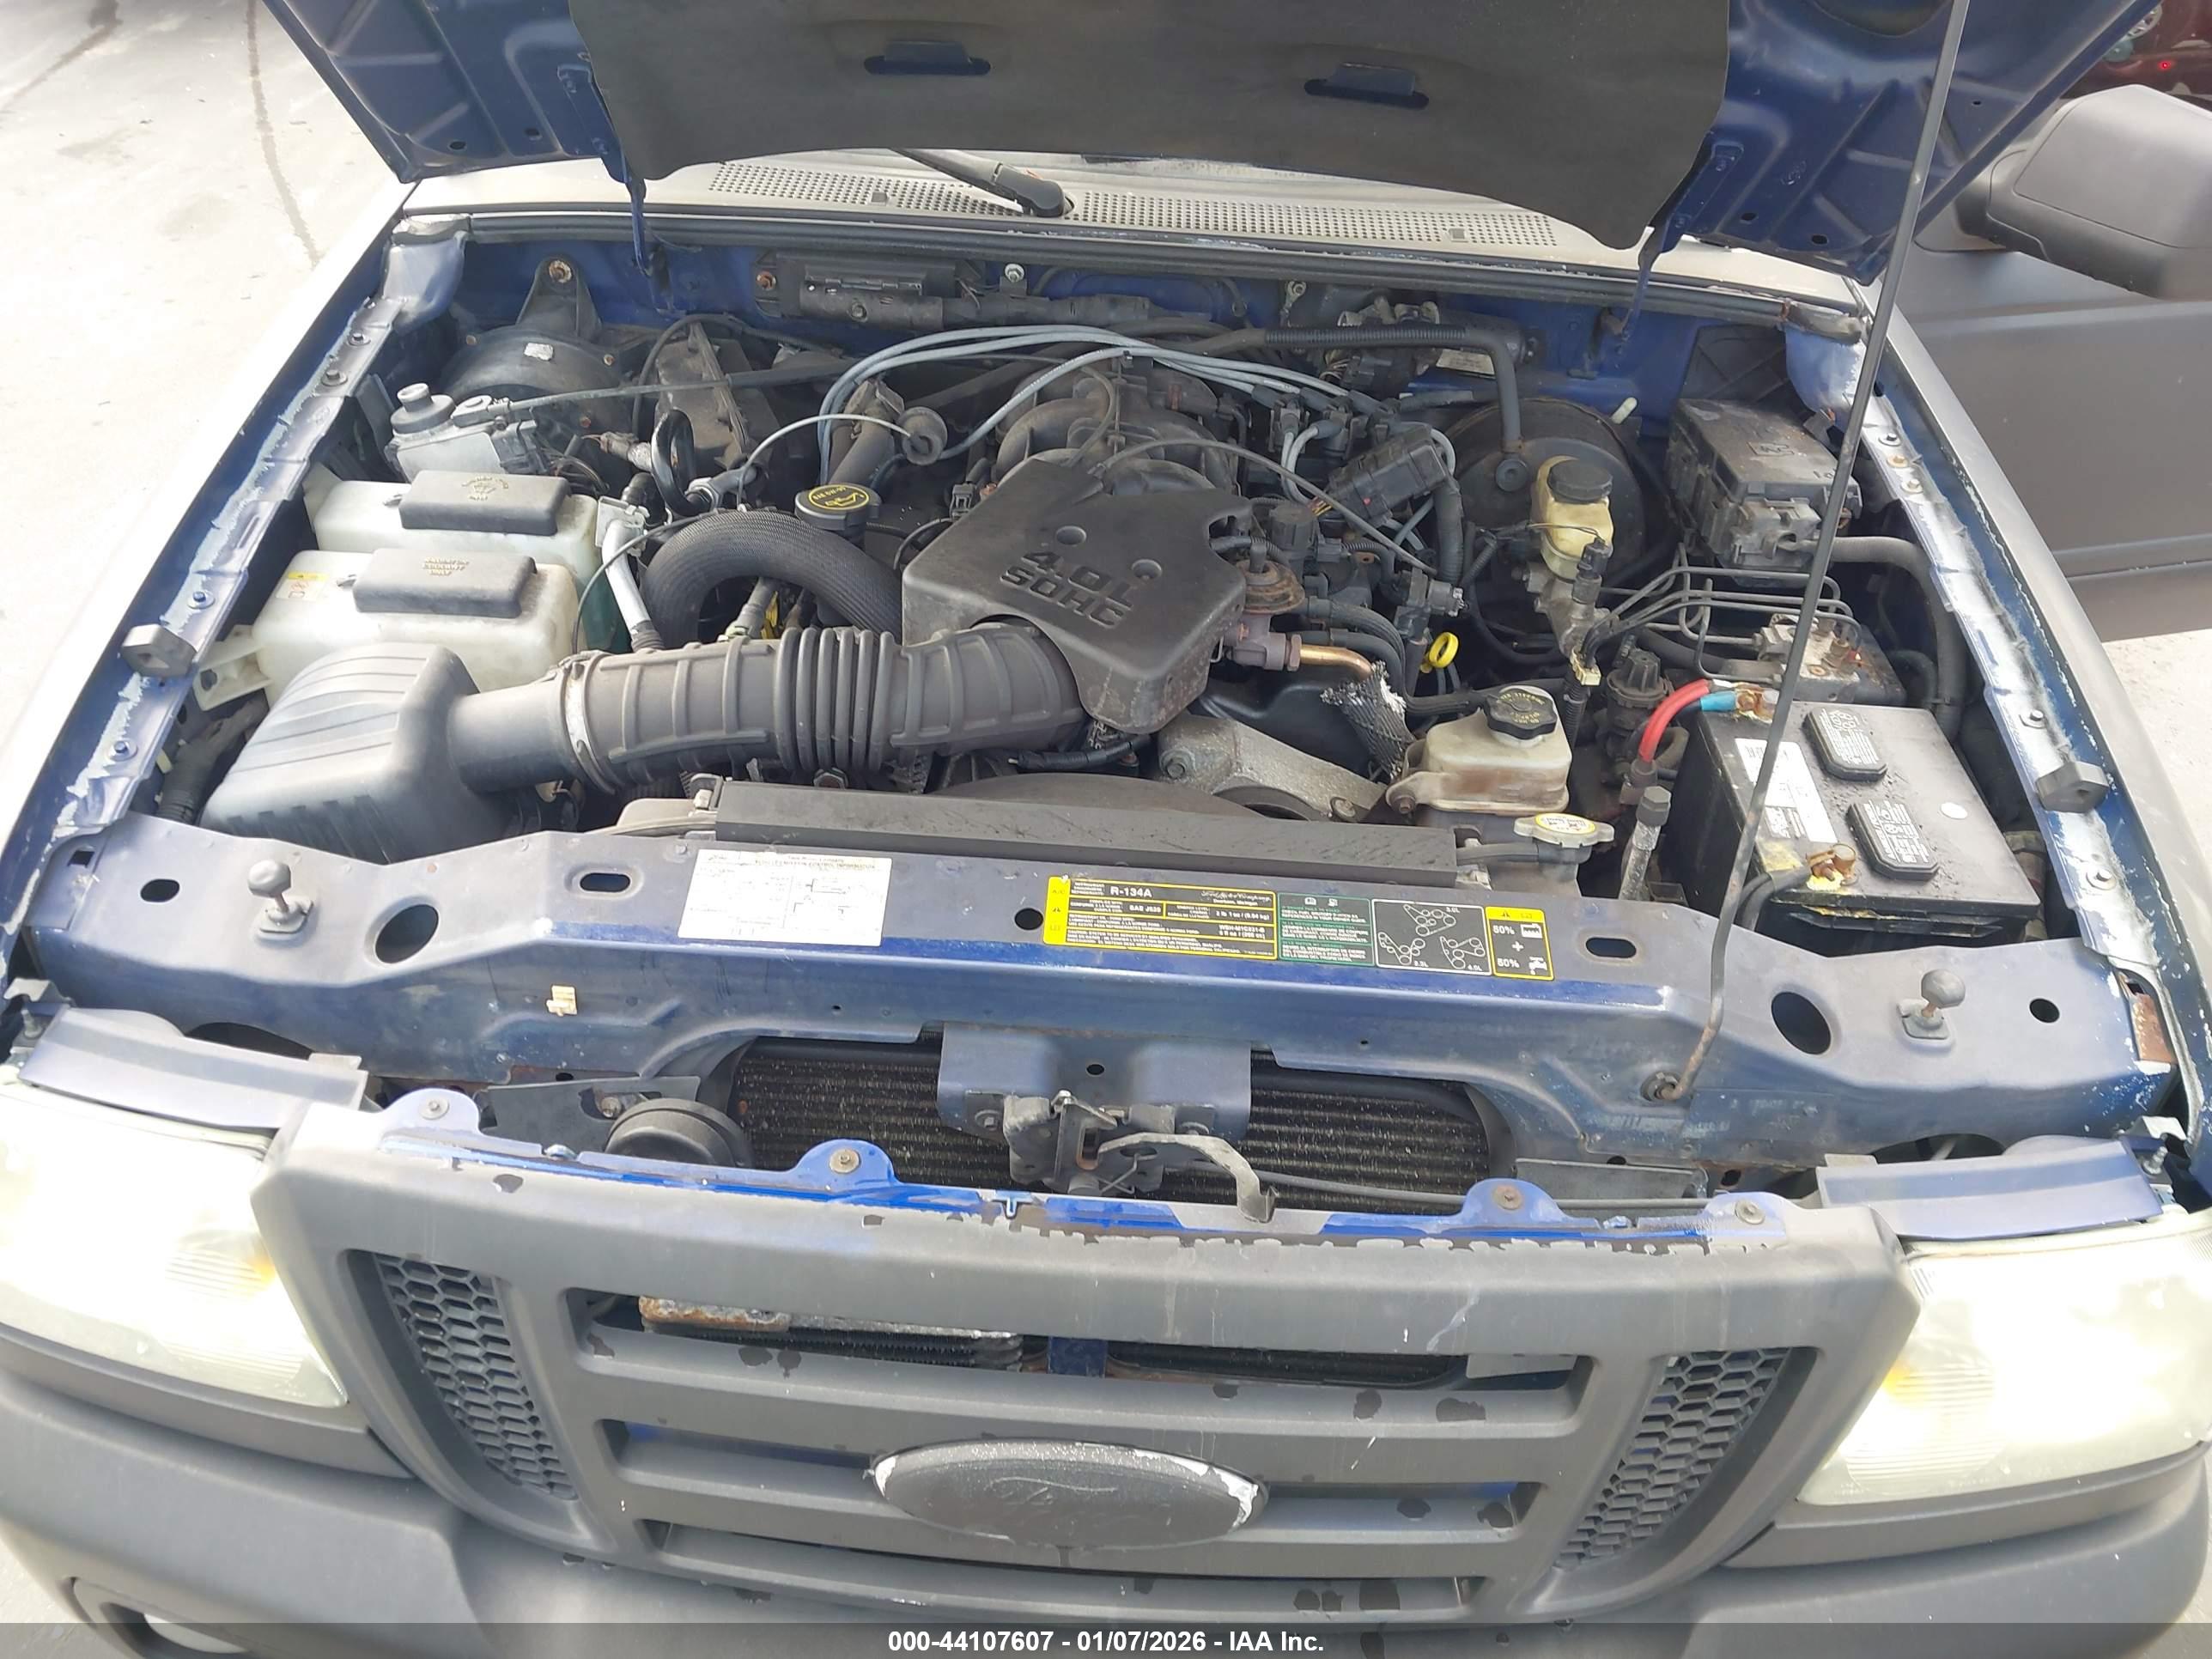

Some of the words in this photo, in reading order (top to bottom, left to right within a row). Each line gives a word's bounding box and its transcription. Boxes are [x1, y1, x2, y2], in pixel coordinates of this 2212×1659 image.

[1000, 564, 1123, 629] SOHC
[1109, 885, 1152, 898] R-134A
[1492, 924, 1516, 935] 50%
[1497, 957, 1520, 968] 50%
